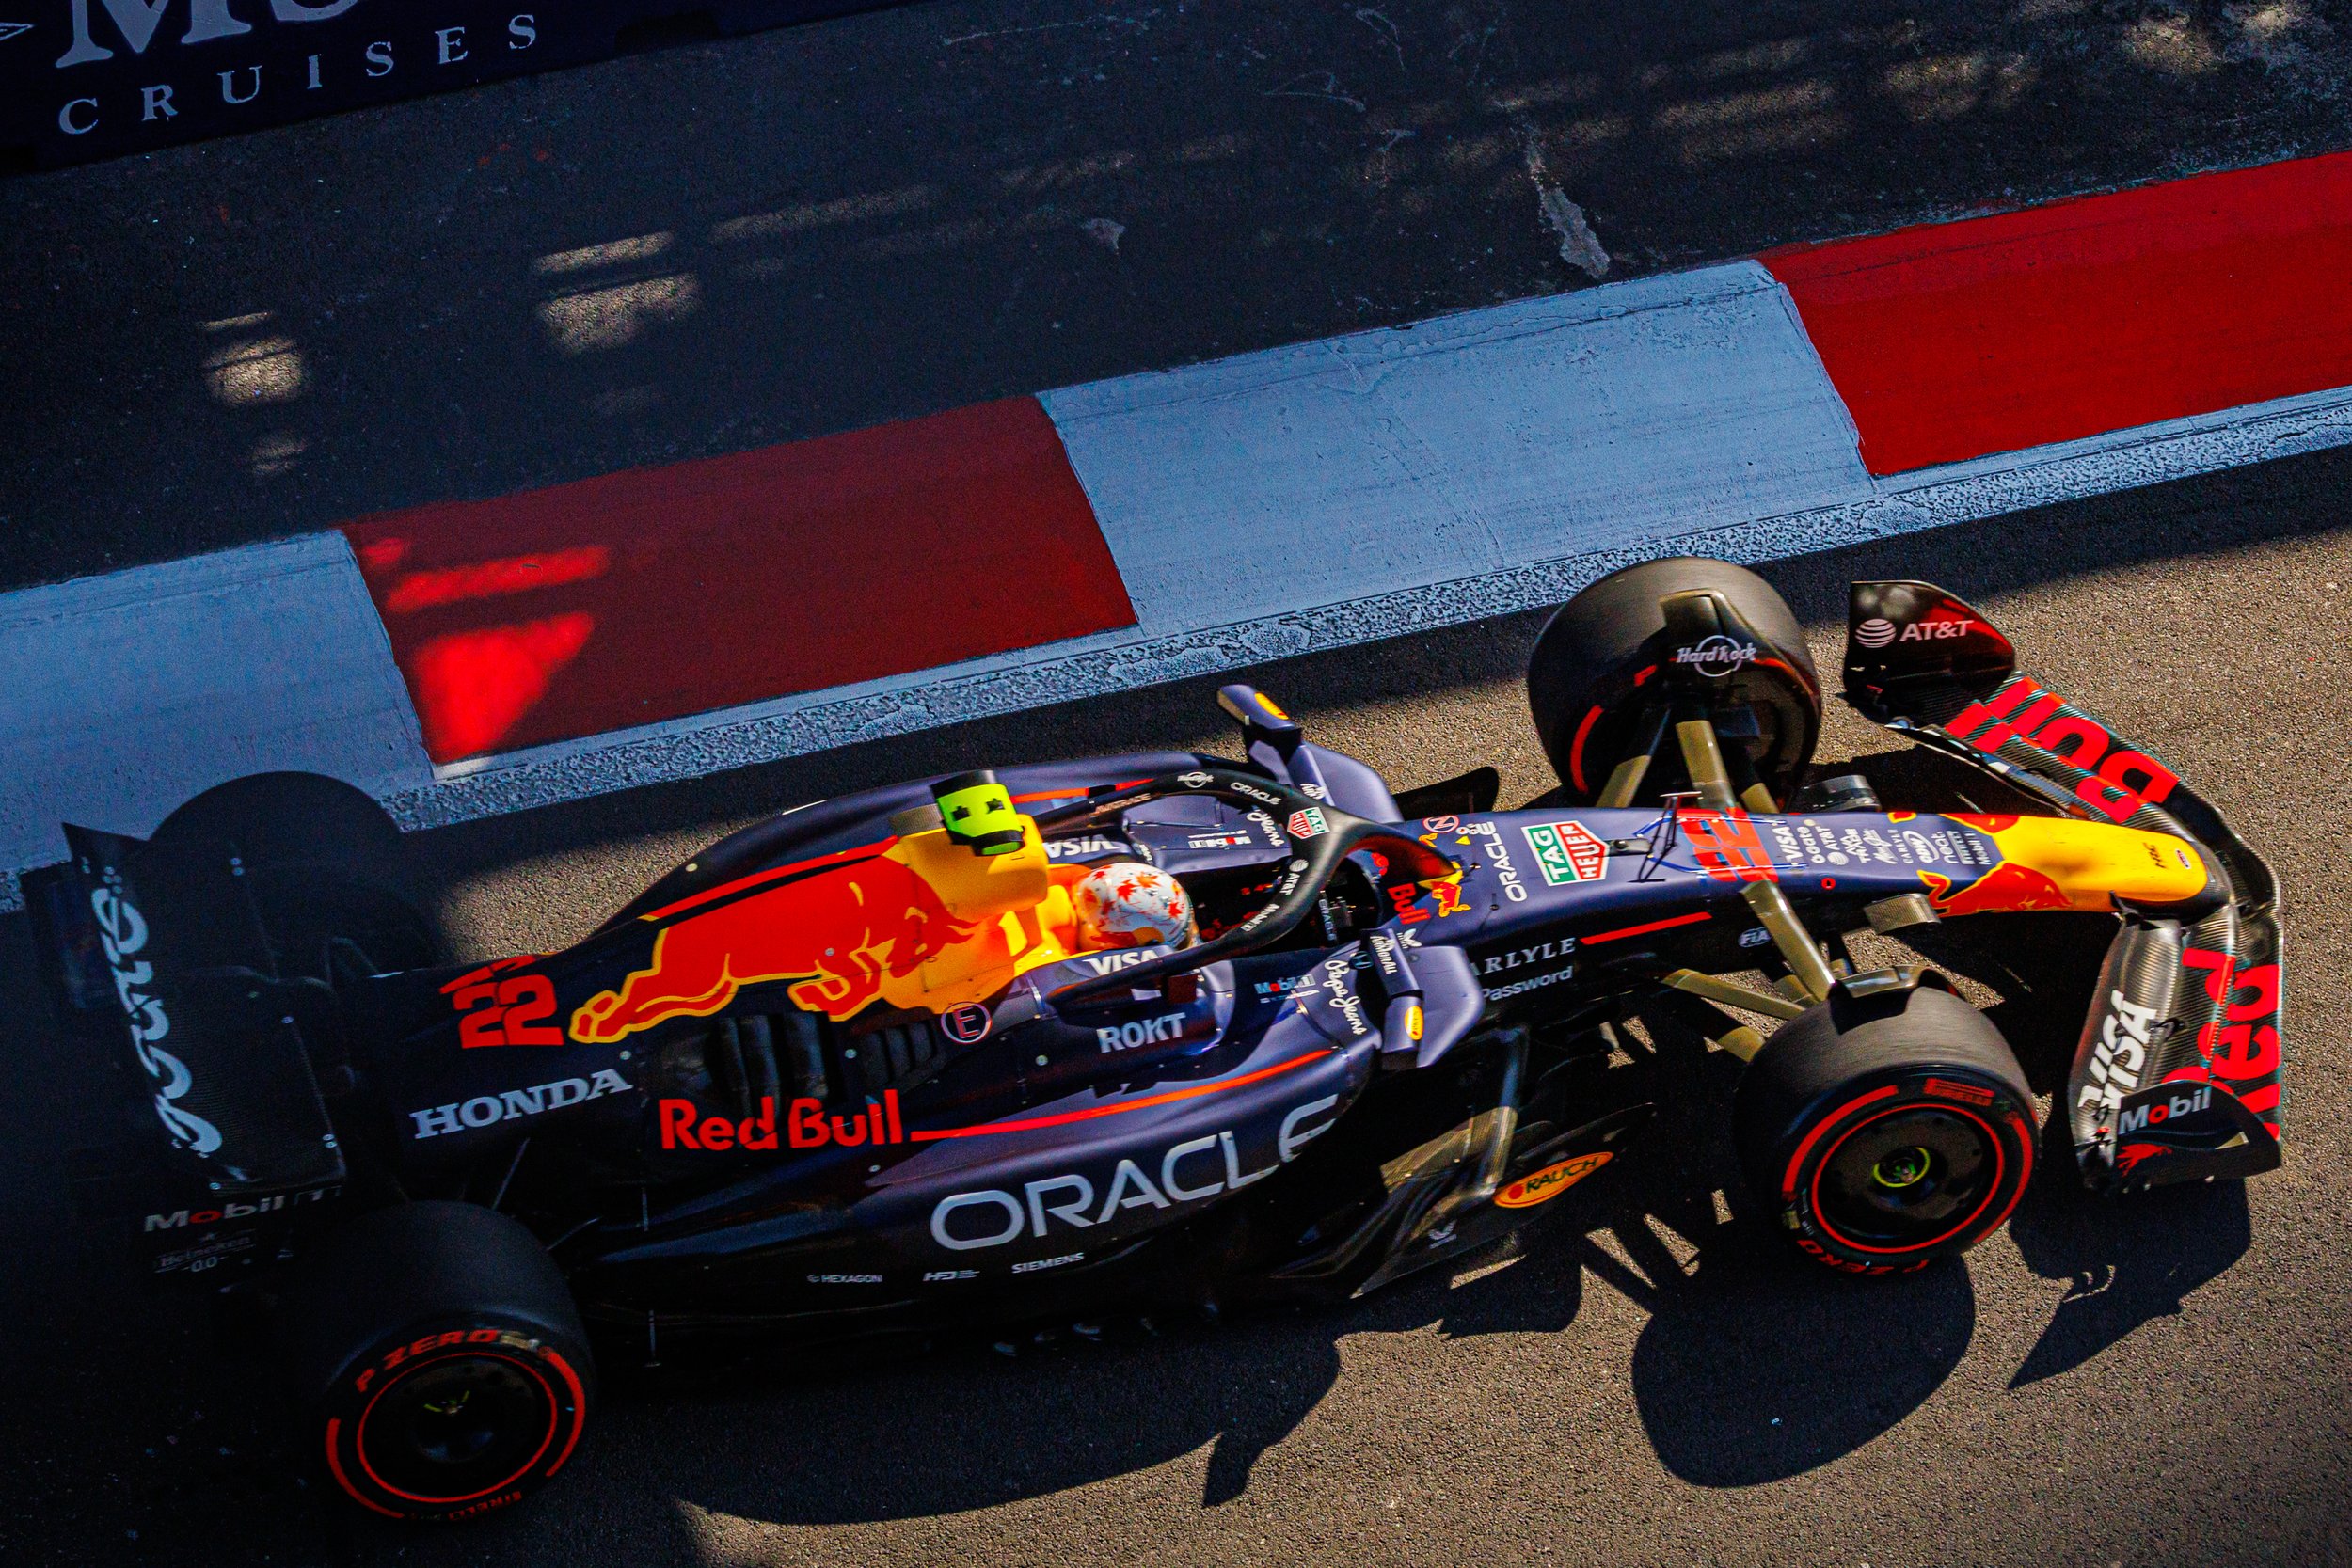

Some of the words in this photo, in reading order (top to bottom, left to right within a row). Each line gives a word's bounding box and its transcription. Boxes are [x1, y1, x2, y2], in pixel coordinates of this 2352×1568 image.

[59, 14, 537, 135] CRUISES
[1900, 619, 1975, 642] AT&T
[1676, 646, 1718, 664] Hard
[1718, 642, 1757, 664] Rock
[1944, 675, 2181, 824] Bull
[1230, 782, 1283, 806] ORACLE
[1043, 834, 1119, 858] VISA
[1246, 810, 1285, 846] Jeans
[1772, 826, 1804, 863] VISA
[1817, 826, 1838, 852] AT&T
[1474, 821, 1528, 902] ORACLE
[1534, 829, 1571, 880] TAG
[1560, 824, 1600, 880] HEUER
[1279, 872, 1301, 895] AT&T
[1388, 883, 1431, 925] Bull
[1083, 948, 1163, 976] VISA
[1470, 937, 1577, 977] ARLYLE
[1322, 959, 1350, 998] Pepe
[1481, 965, 1574, 1002] Password
[452, 974, 566, 1050] 22
[953, 1006, 981, 1039] E
[1328, 995, 1368, 1036] Jeans
[1096, 1011, 1187, 1054] ROKT
[2076, 989, 2158, 1110] VISA
[409, 1069, 634, 1140] HONDA
[659, 1095, 776, 1151] Red
[787, 1089, 904, 1148] Bull
[2119, 1086, 2211, 1136] Mobil
[930, 1093, 1338, 1251] ORACLE
[1524, 1157, 1599, 1194] RAUCH
[143, 1195, 287, 1233] Mobil
[820, 1273, 883, 1285] HEXAGON
[1010, 1251, 1086, 1275] SIEMENS
[382, 1328, 501, 1371] ZERO
